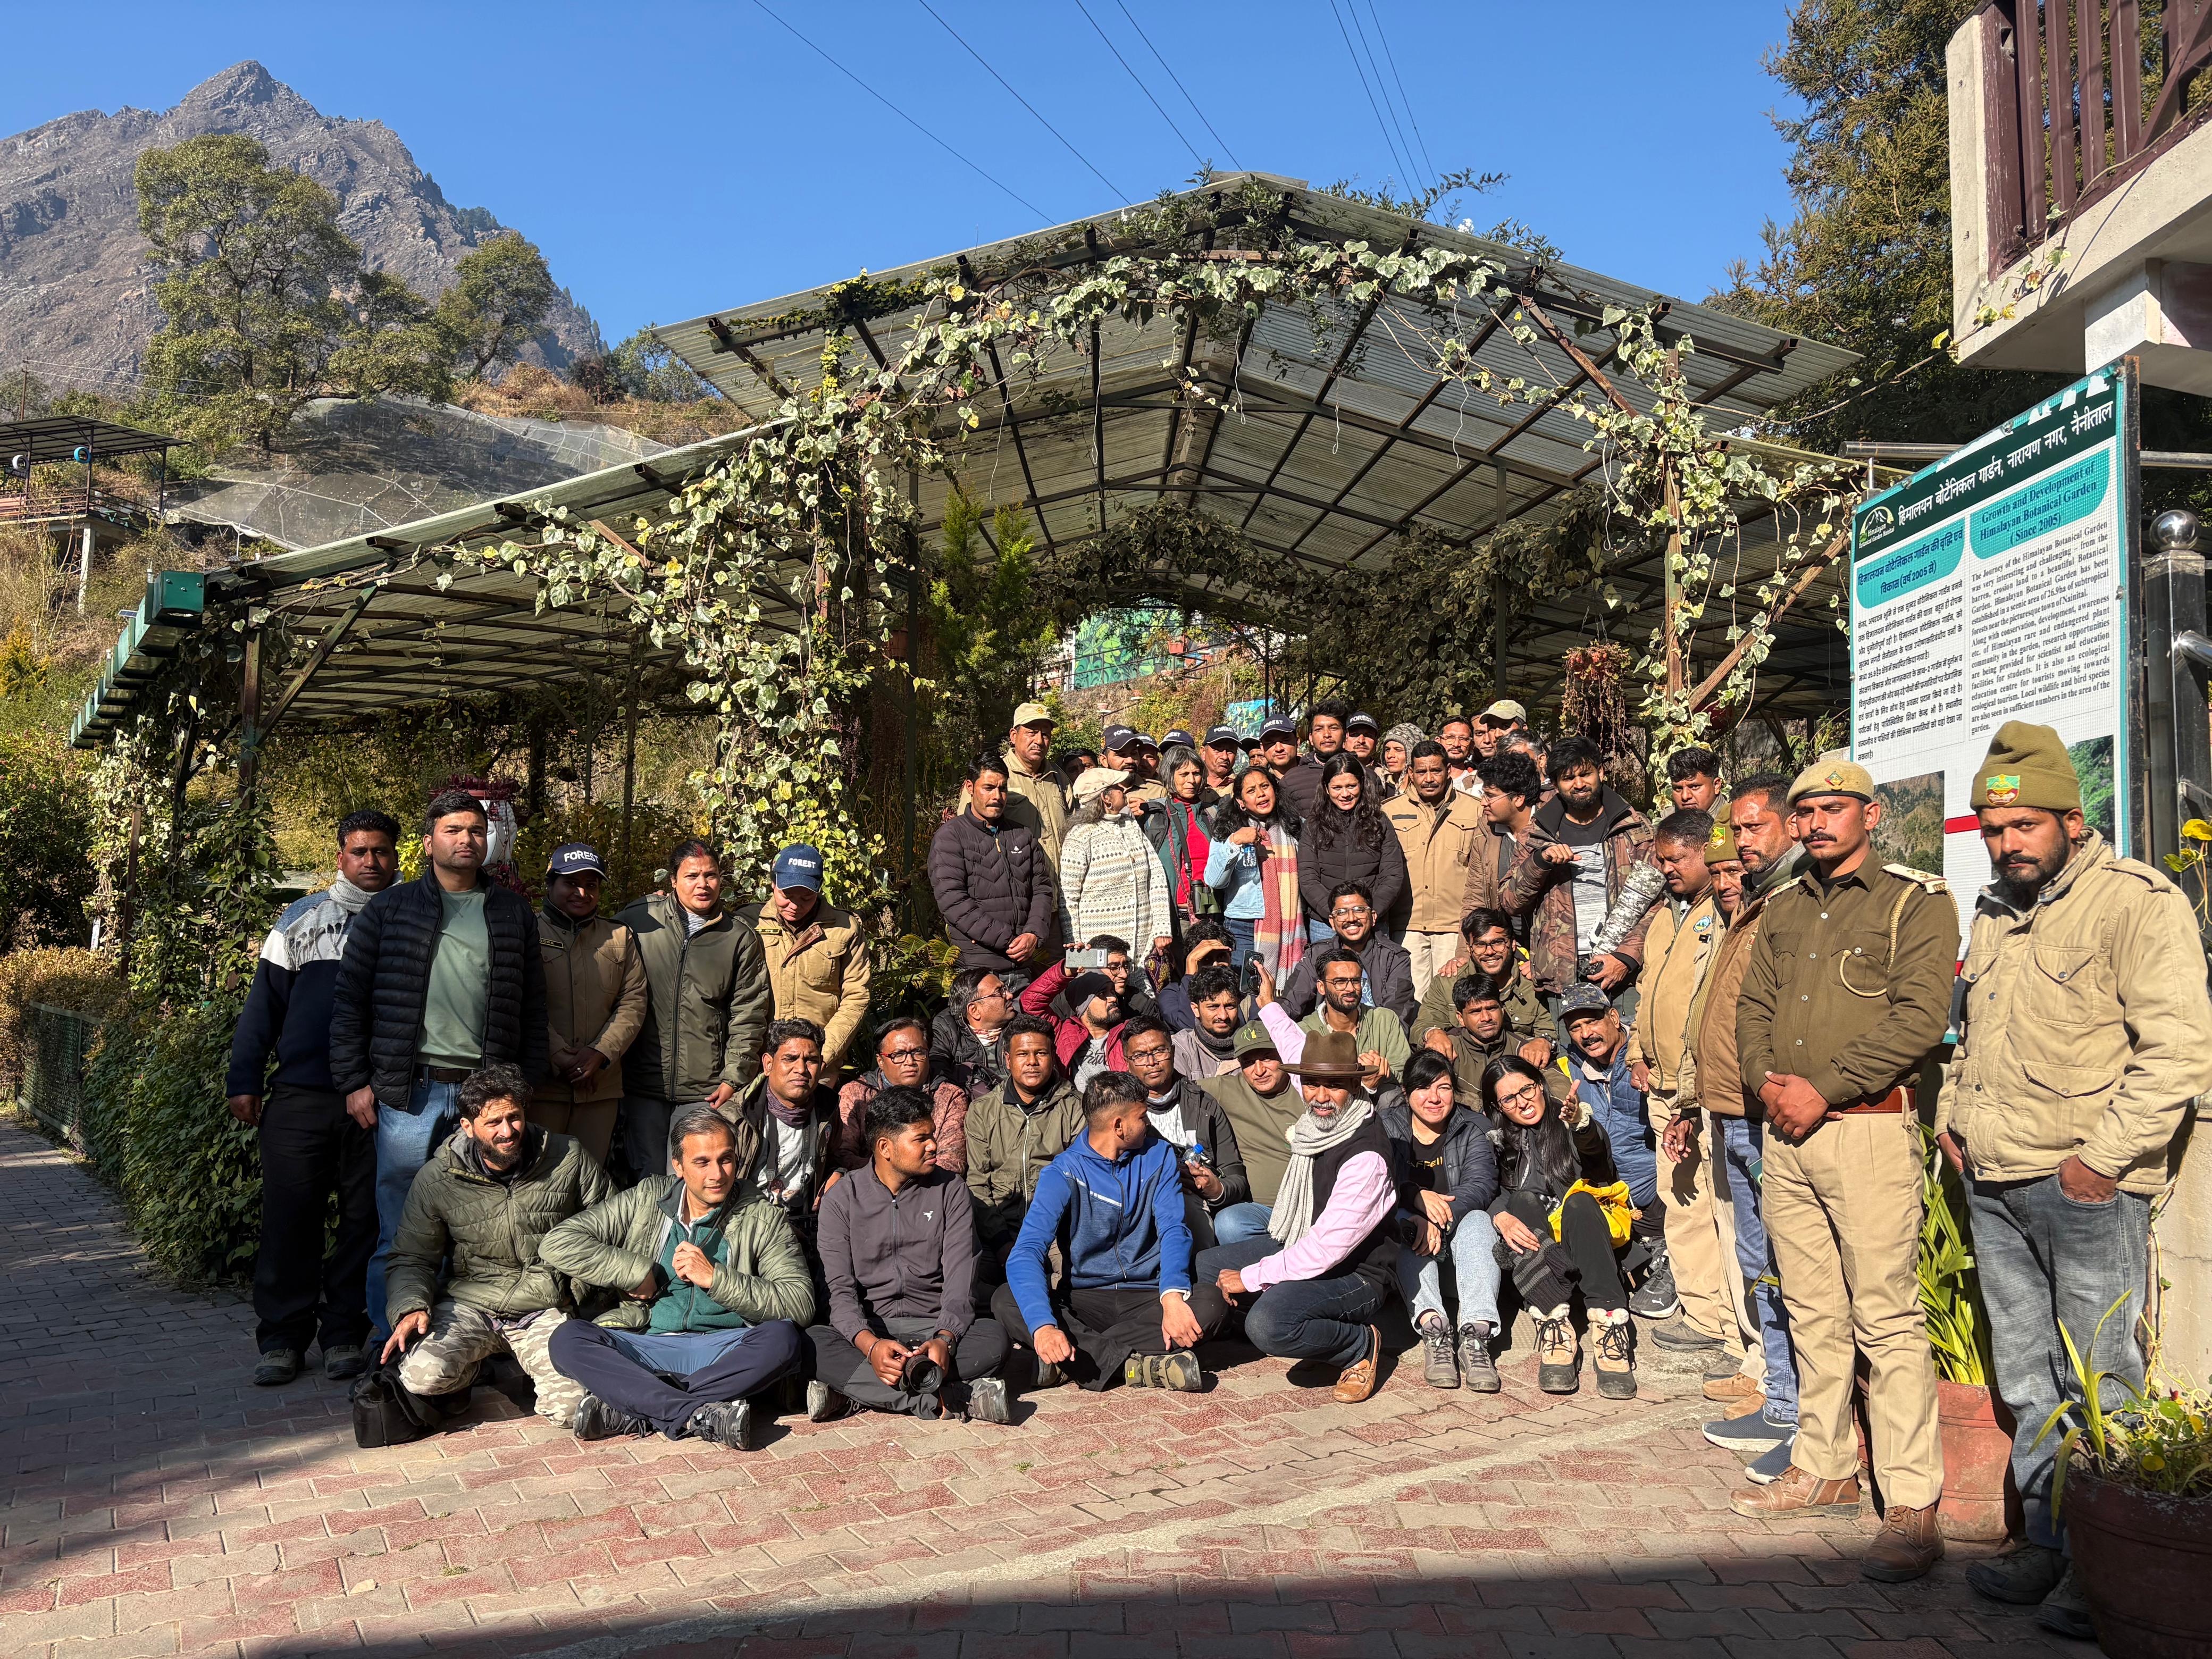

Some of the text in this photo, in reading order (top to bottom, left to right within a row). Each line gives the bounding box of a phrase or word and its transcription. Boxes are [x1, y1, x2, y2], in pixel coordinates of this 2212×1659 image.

[1898, 400, 2113, 526] हिमालयन बोटैनिकल गार्डन, नारायण नगर, नैनीताल
[1980, 477, 2098, 542] Himalayan Botanical Garden
[1982, 459, 2095, 525] Growth and Development of
[2015, 522, 2037, 544] Since
[2038, 512, 2061, 535] 2005)
[1858, 524, 1963, 585] हिमालयन बोटैनिकल गार्डन की वृद्धि एवं
[1972, 521, 2107, 582] The Journey of the Himalayan Botanical Garden
[1972, 592, 1991, 604] barren,
[1993, 583, 2013, 595] erosion
[2016, 575, 2029, 586] land
[2047, 557, 2074, 575] beautiful
[2078, 543, 2108, 563] Botanical
[1983, 579, 1994, 588] very
[1996, 567, 2024, 583] interesting
[2026, 560, 2037, 572] and
[2039, 548, 2072, 566] challenging
[2080, 539, 2096, 550] from
[2098, 533, 2108, 543] the
[1880, 560, 1937, 595] विकास (वर्ष 2005 से)
[1995, 590, 2023, 606] Himalayan
[2026, 577, 2052, 594] Botanical
[2055, 570, 2077, 583] Garden
[2080, 565, 2091, 574] has
[2093, 558, 2108, 569] been
[2010, 599, 2026, 611] scenic
[2027, 596, 2040, 605] area
[2040, 591, 2047, 600] of
[2067, 581, 2074, 591] of
[2074, 568, 2109, 588] subtropical
[1972, 589, 2088, 636] forests near the picturesque town of Nainital.
[1972, 636, 1987, 647] Along
[1988, 631, 1999, 641] with
[2078, 595, 2109, 611] awareness
[1983, 645, 1989, 653] of
[1991, 636, 2021, 651] Himalayan
[2024, 631, 2037, 641] rare
[2039, 624, 2050, 635] and
[2054, 611, 2089, 631] endangered
[2092, 606, 2109, 621] plant
[1982, 666, 1997, 676] being
[1999, 656, 2024, 673] provided
[2026, 654, 2035, 663] for
[2038, 646, 2062, 659] scientist
[2064, 640, 2076, 651] and
[2079, 632, 2110, 647] education
[2009, 648, 2017, 657] the
[2020, 642, 2040, 656] garden,
[2042, 632, 2067, 646] research
[2069, 619, 2110, 639] opportunities
[1971, 655, 2110, 701] education centre for tourists moving towards
[1972, 678, 1994, 690] facilities
[2007, 667, 2033, 680] students.
[2035, 663, 2041, 672] It
[2052, 658, 2064, 667] also
[2078, 642, 2110, 659] ecological
[1971, 668, 2110, 711] ecological tourism. Local wildlife and bird species
[1980, 712, 1990, 720] also
[2035, 694, 2060, 706] numbers
[2061, 691, 2067, 700] in
[2068, 689, 2077, 698] the
[2079, 686, 2092, 695] area
[2092, 682, 2100, 691] of
[2100, 681, 2110, 689] the
[1263, 719, 1283, 729] FOREST
[1350, 715, 1372, 723] FOREST
[1971, 723, 1991, 735] garden.
[564, 850, 599, 865] FOREST
[788, 858, 816, 869] FOREST
